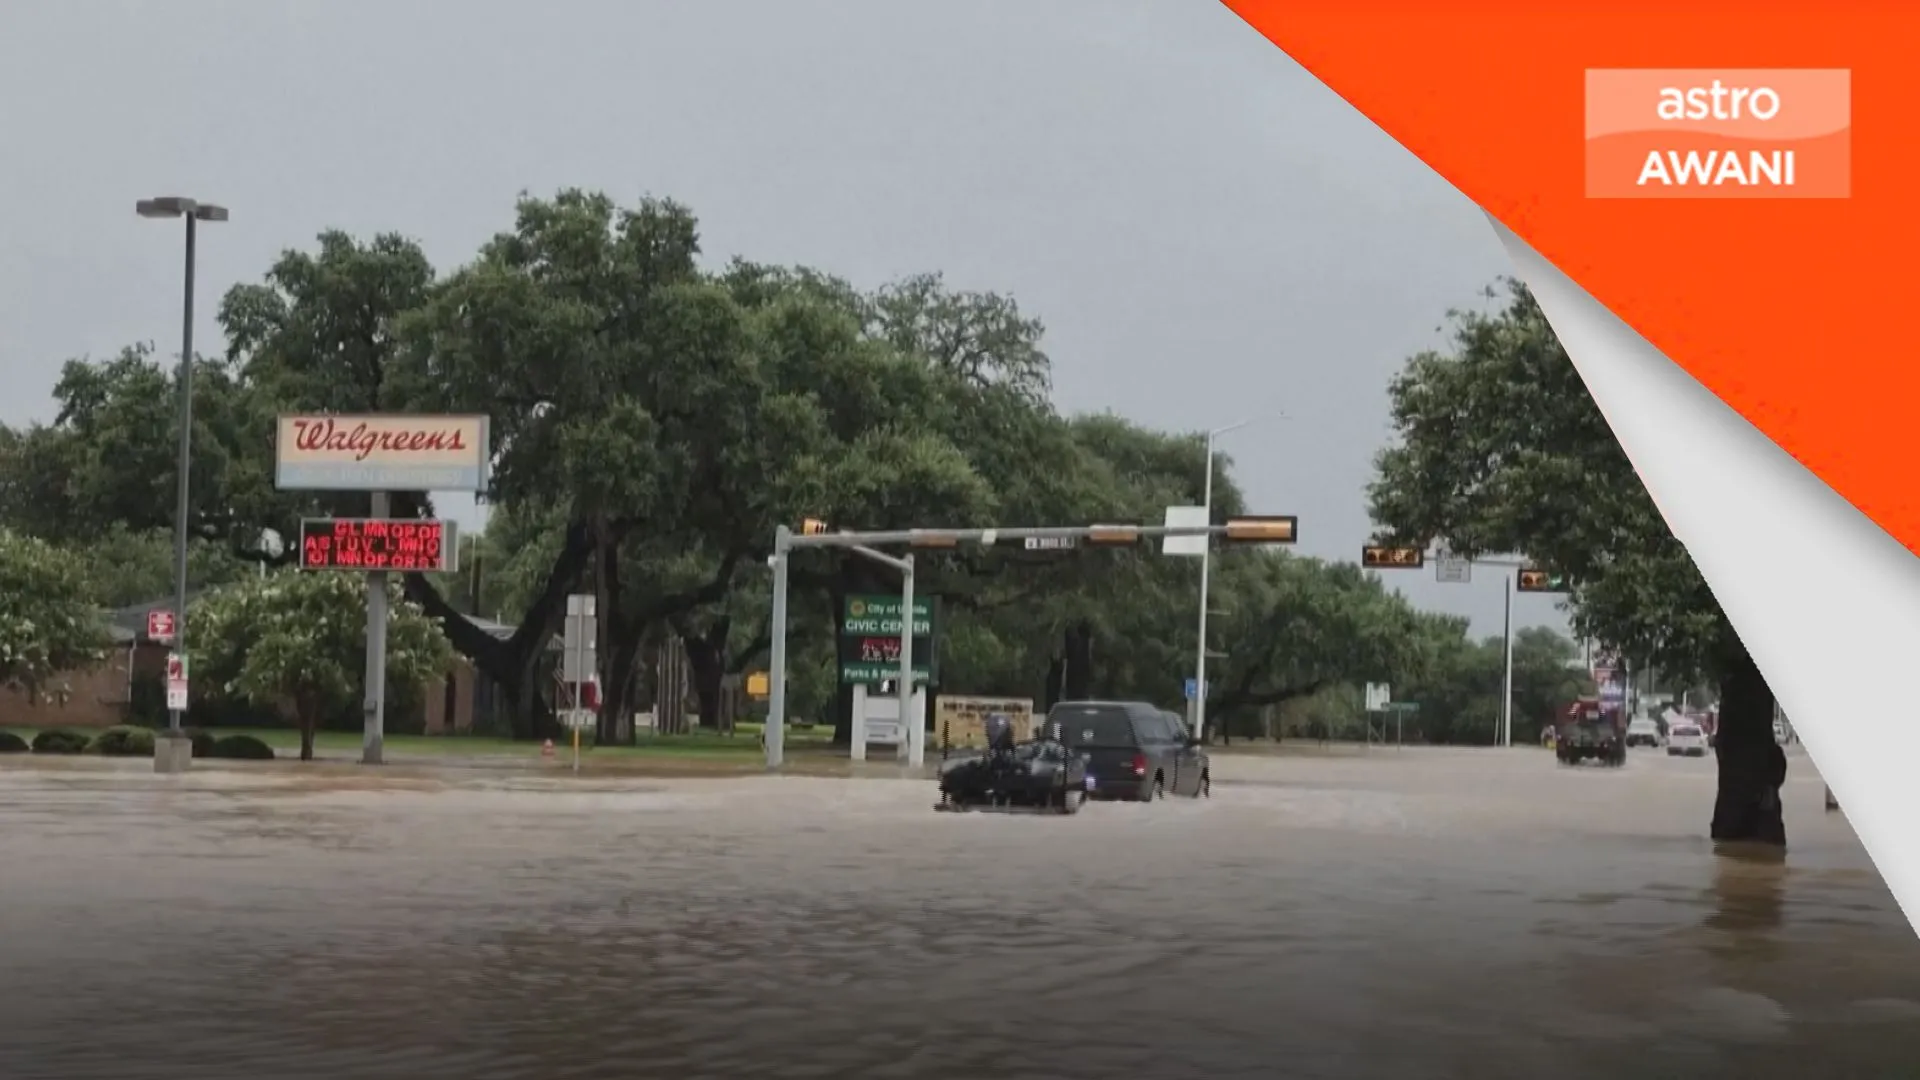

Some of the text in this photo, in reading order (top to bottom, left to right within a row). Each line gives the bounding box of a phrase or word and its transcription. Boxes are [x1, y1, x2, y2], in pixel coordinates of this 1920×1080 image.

[294, 418, 466, 461] Walgreens
[867, 603, 885, 615] City
[886, 604, 896, 614] of
[845, 620, 930, 634] CIVIC CENER
[844, 668, 869, 679] Parks
